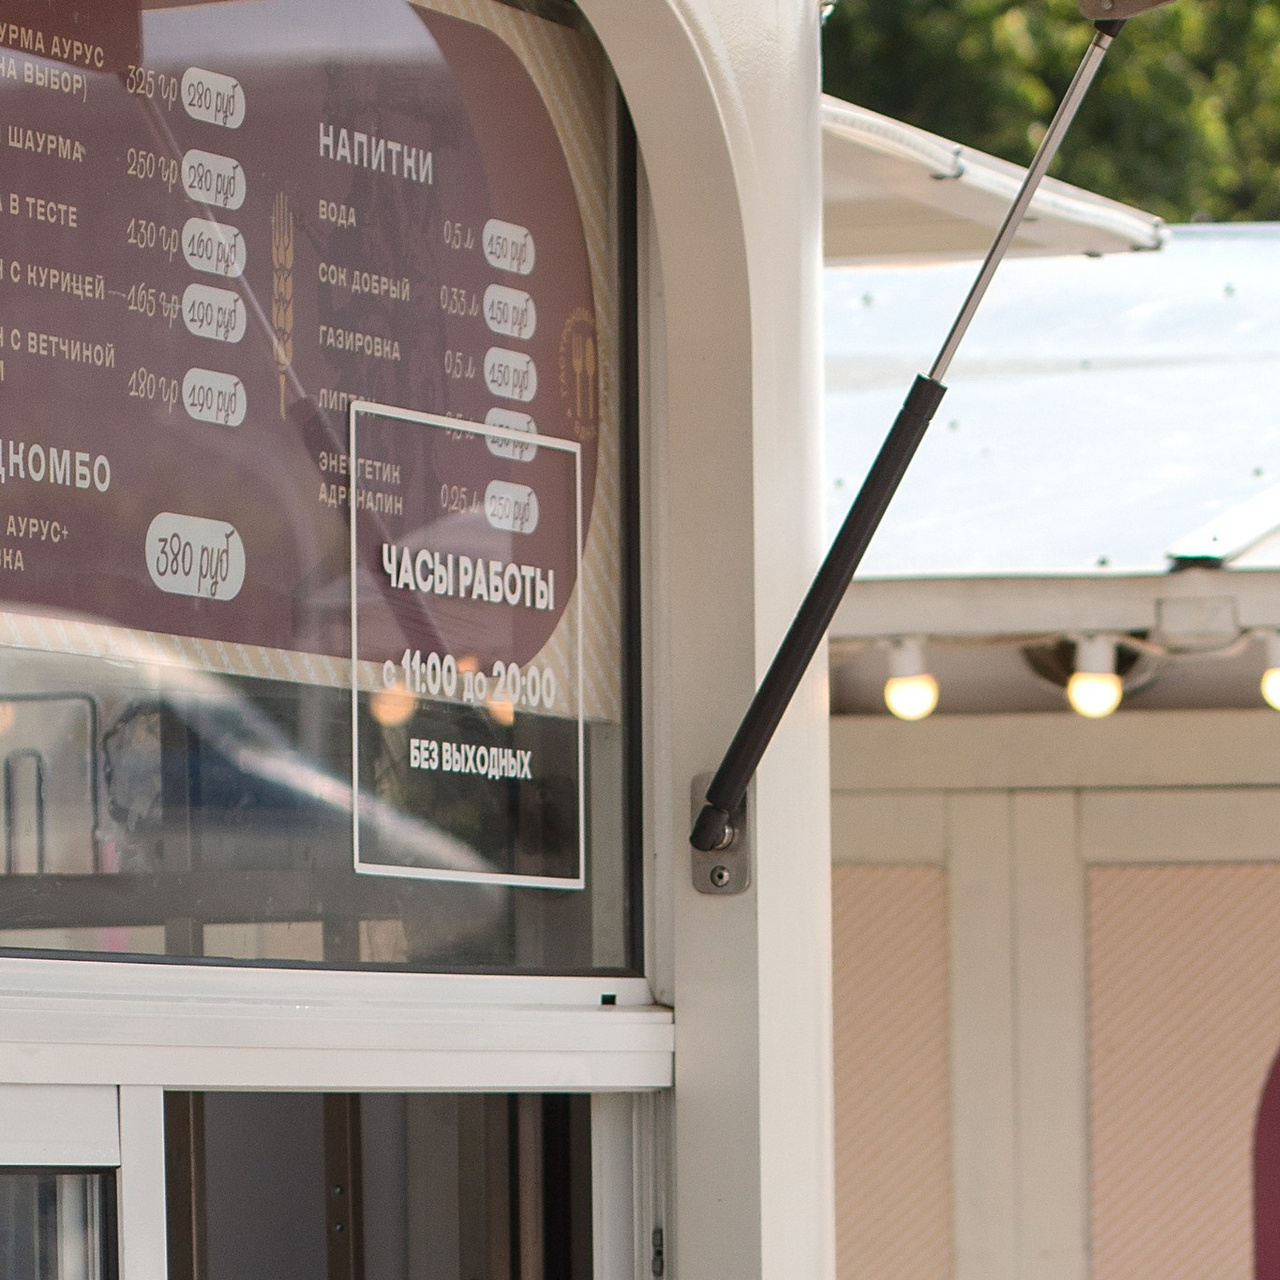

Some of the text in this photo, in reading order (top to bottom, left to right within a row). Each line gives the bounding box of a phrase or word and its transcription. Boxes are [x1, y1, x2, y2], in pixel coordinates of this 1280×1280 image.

[51, 36, 104, 67] АУРУС
[24, 62, 87, 102] ВЫБОР)
[126, 65, 155, 98] 325
[187, 81, 212, 110] 280
[214, 83, 239, 125] руб
[8, 125, 83, 162] ШАУРМА
[319, 122, 434, 184] НАПИТКИ
[127, 148, 155, 179] 250
[188, 163, 212, 193] 280
[214, 165, 239, 206] руб
[9, 193, 19, 215] В
[26, 196, 78, 228] ТЕСТЕ
[318, 199, 356, 228] ВОДА
[126, 218, 155, 248] 130
[188, 232, 212, 260] 160
[215, 232, 240, 275] руб
[10, 261, 21, 282] С
[27, 264, 105, 300] КУРИЦЕЙ
[318, 262, 411, 301] СОК ДОБРЫЙ
[127, 282, 156, 317] 165
[188, 300, 212, 329] 190
[214, 296, 240, 340] руб
[10, 328, 21, 350] С
[28, 332, 115, 368] ВЕТЧИНОЙ
[318, 325, 401, 361] ГАЗИРОВКА
[128, 367, 155, 399] 180
[188, 384, 212, 412] 190
[214, 381, 240, 424] руб
[318, 451, 401, 484] ЭНЕГЕТИК
[318, 483, 403, 515] АДРНАЛИН
[6, 515, 69, 543] АУРУС+
[0, 548, 24, 571] КА
[156, 529, 235, 597] 380 руб
[383, 543, 555, 610] ЧАСЫ РАБОТЫ
[401, 648, 458, 696] 11:00
[492, 660, 556, 708] 20:00
[410, 738, 533, 780] БЕЗ ВЫХОДНЫХ
